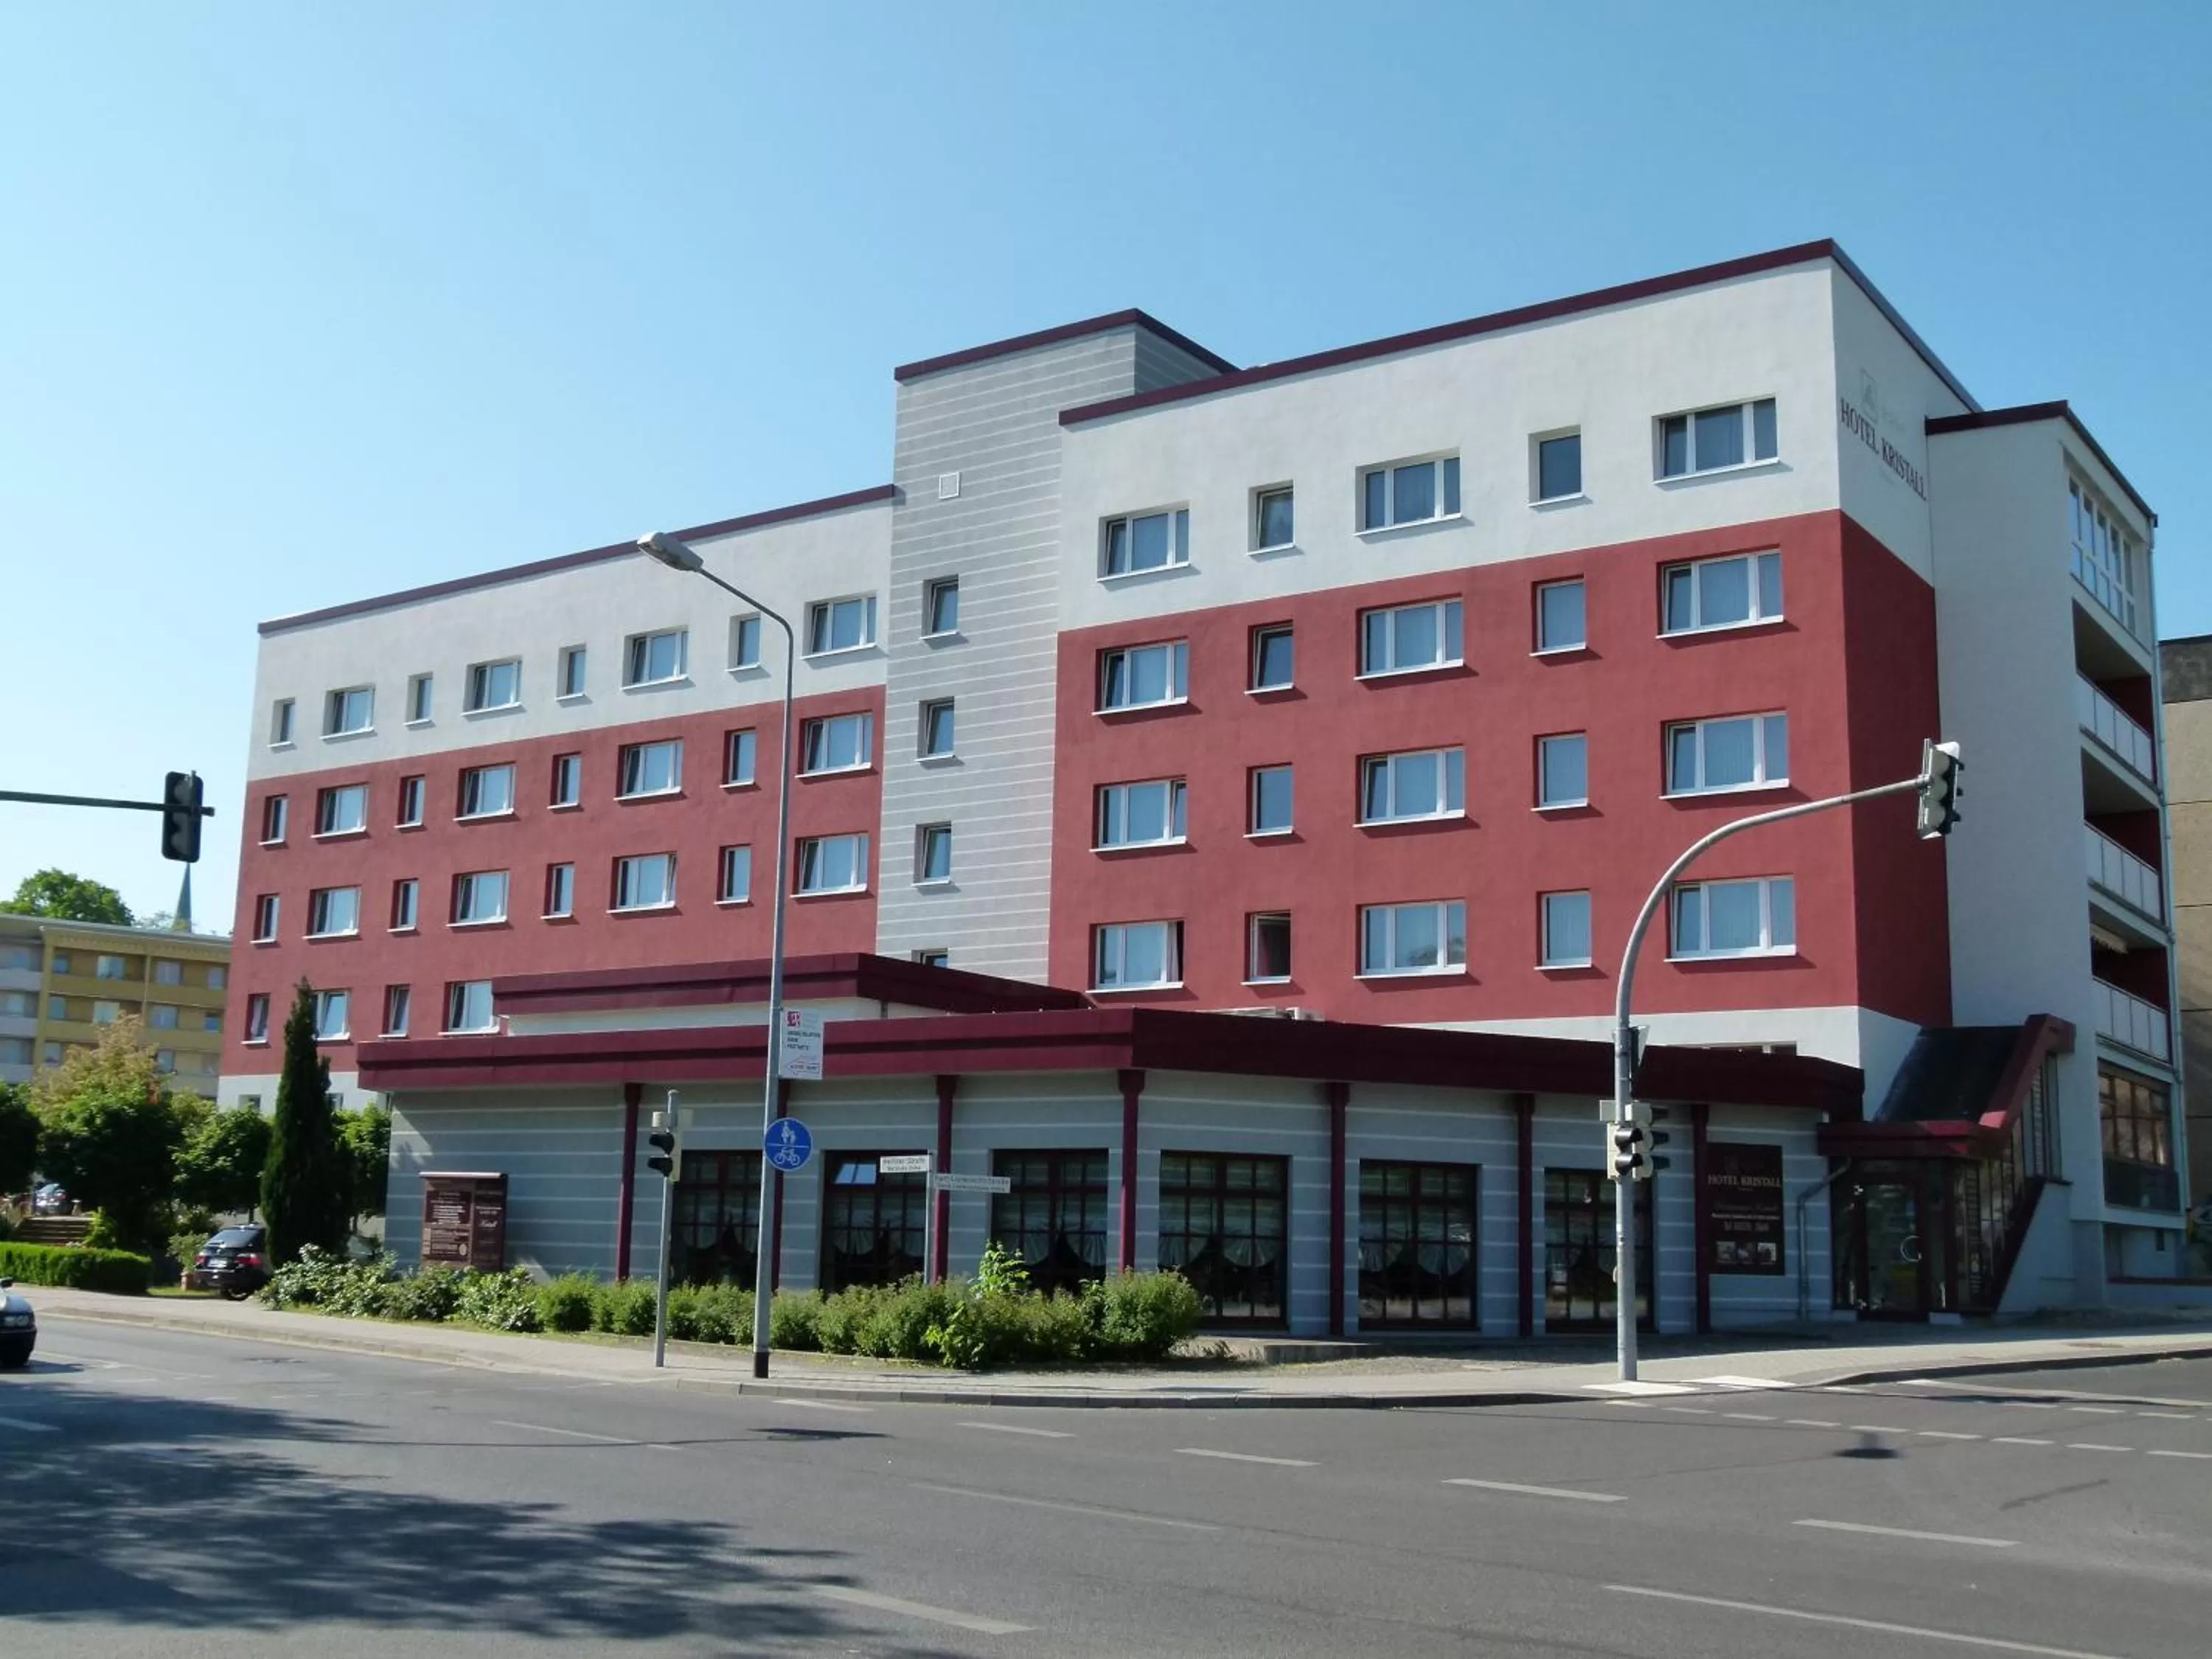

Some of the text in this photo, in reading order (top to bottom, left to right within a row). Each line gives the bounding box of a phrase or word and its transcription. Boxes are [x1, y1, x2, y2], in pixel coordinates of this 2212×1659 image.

[1840, 397, 1927, 502] HOTEL KRISTALL
[1708, 1174, 1739, 1186] HOTEL
